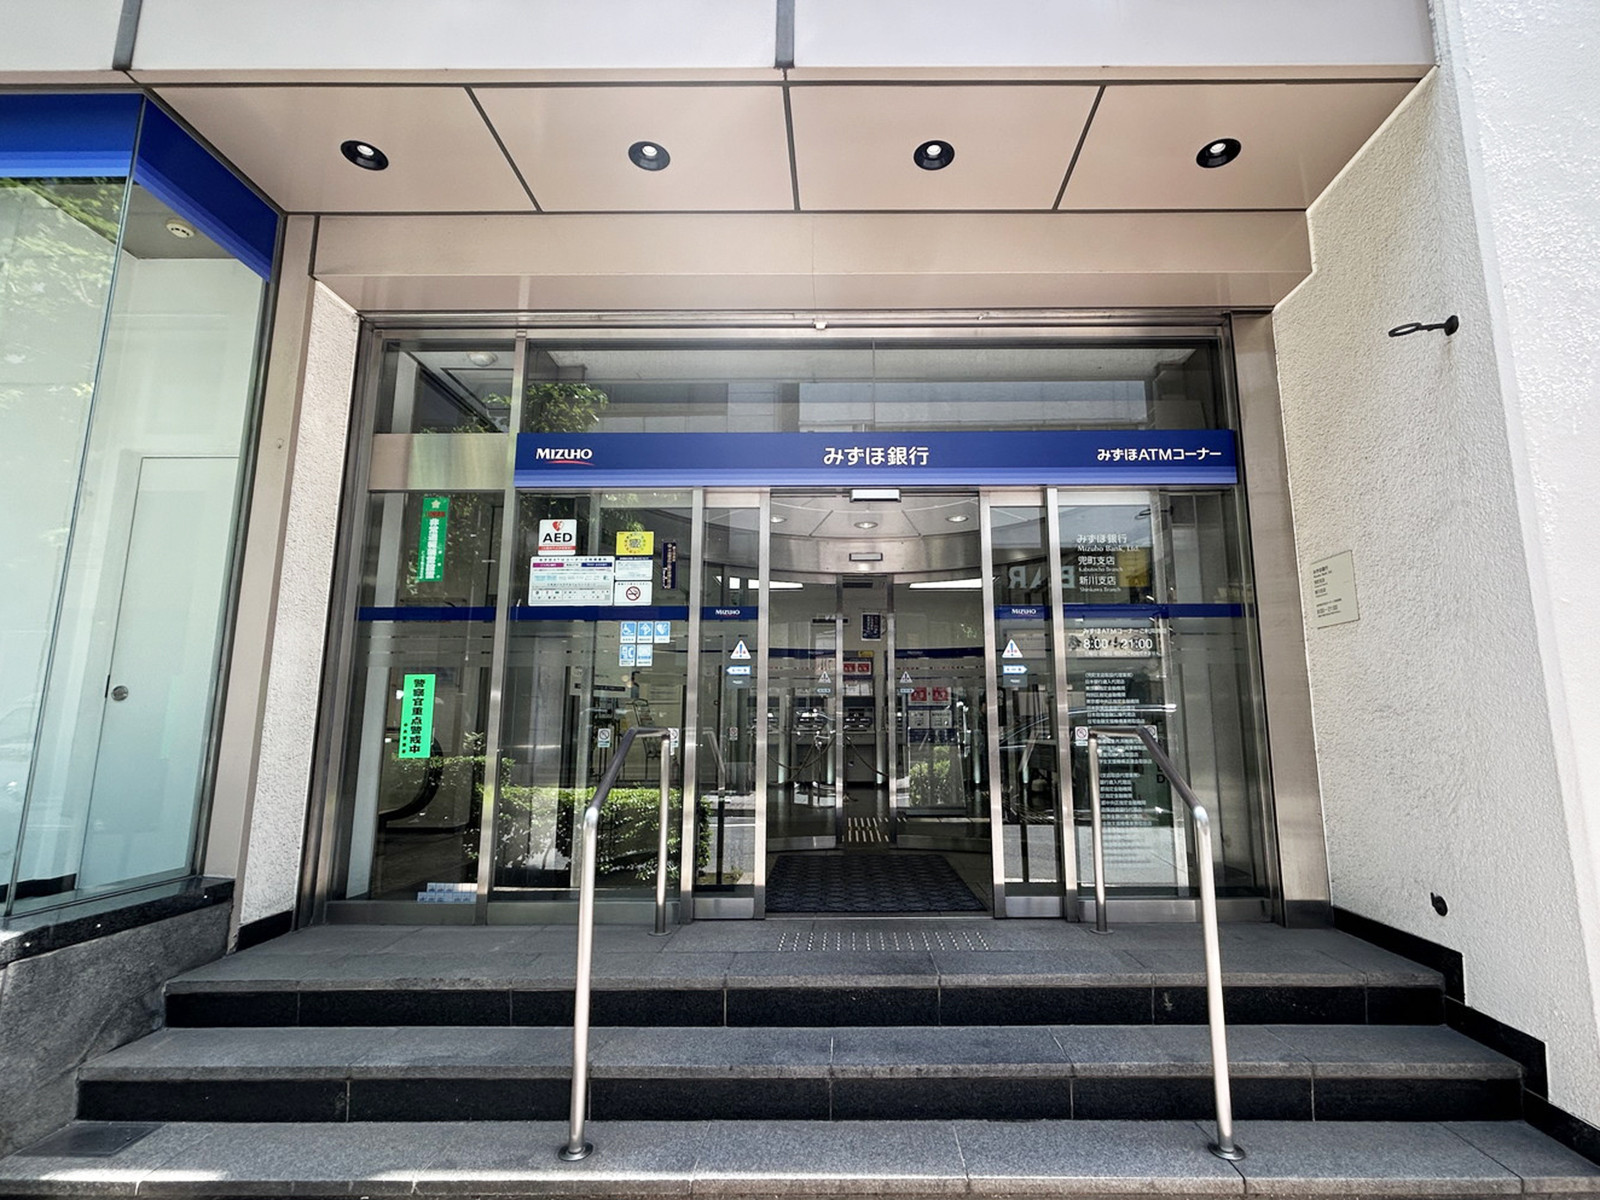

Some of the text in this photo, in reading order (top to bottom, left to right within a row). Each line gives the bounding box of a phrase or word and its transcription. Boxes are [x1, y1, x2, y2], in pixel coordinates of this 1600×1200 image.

[535, 447, 593, 460] MIZUHO
[823, 446, 929, 466] みずほ銀行
[1096, 447, 1222, 461] みずほATMコーナー
[542, 532, 573, 543] AED
[1076, 533, 1128, 544] みずほ銀行
